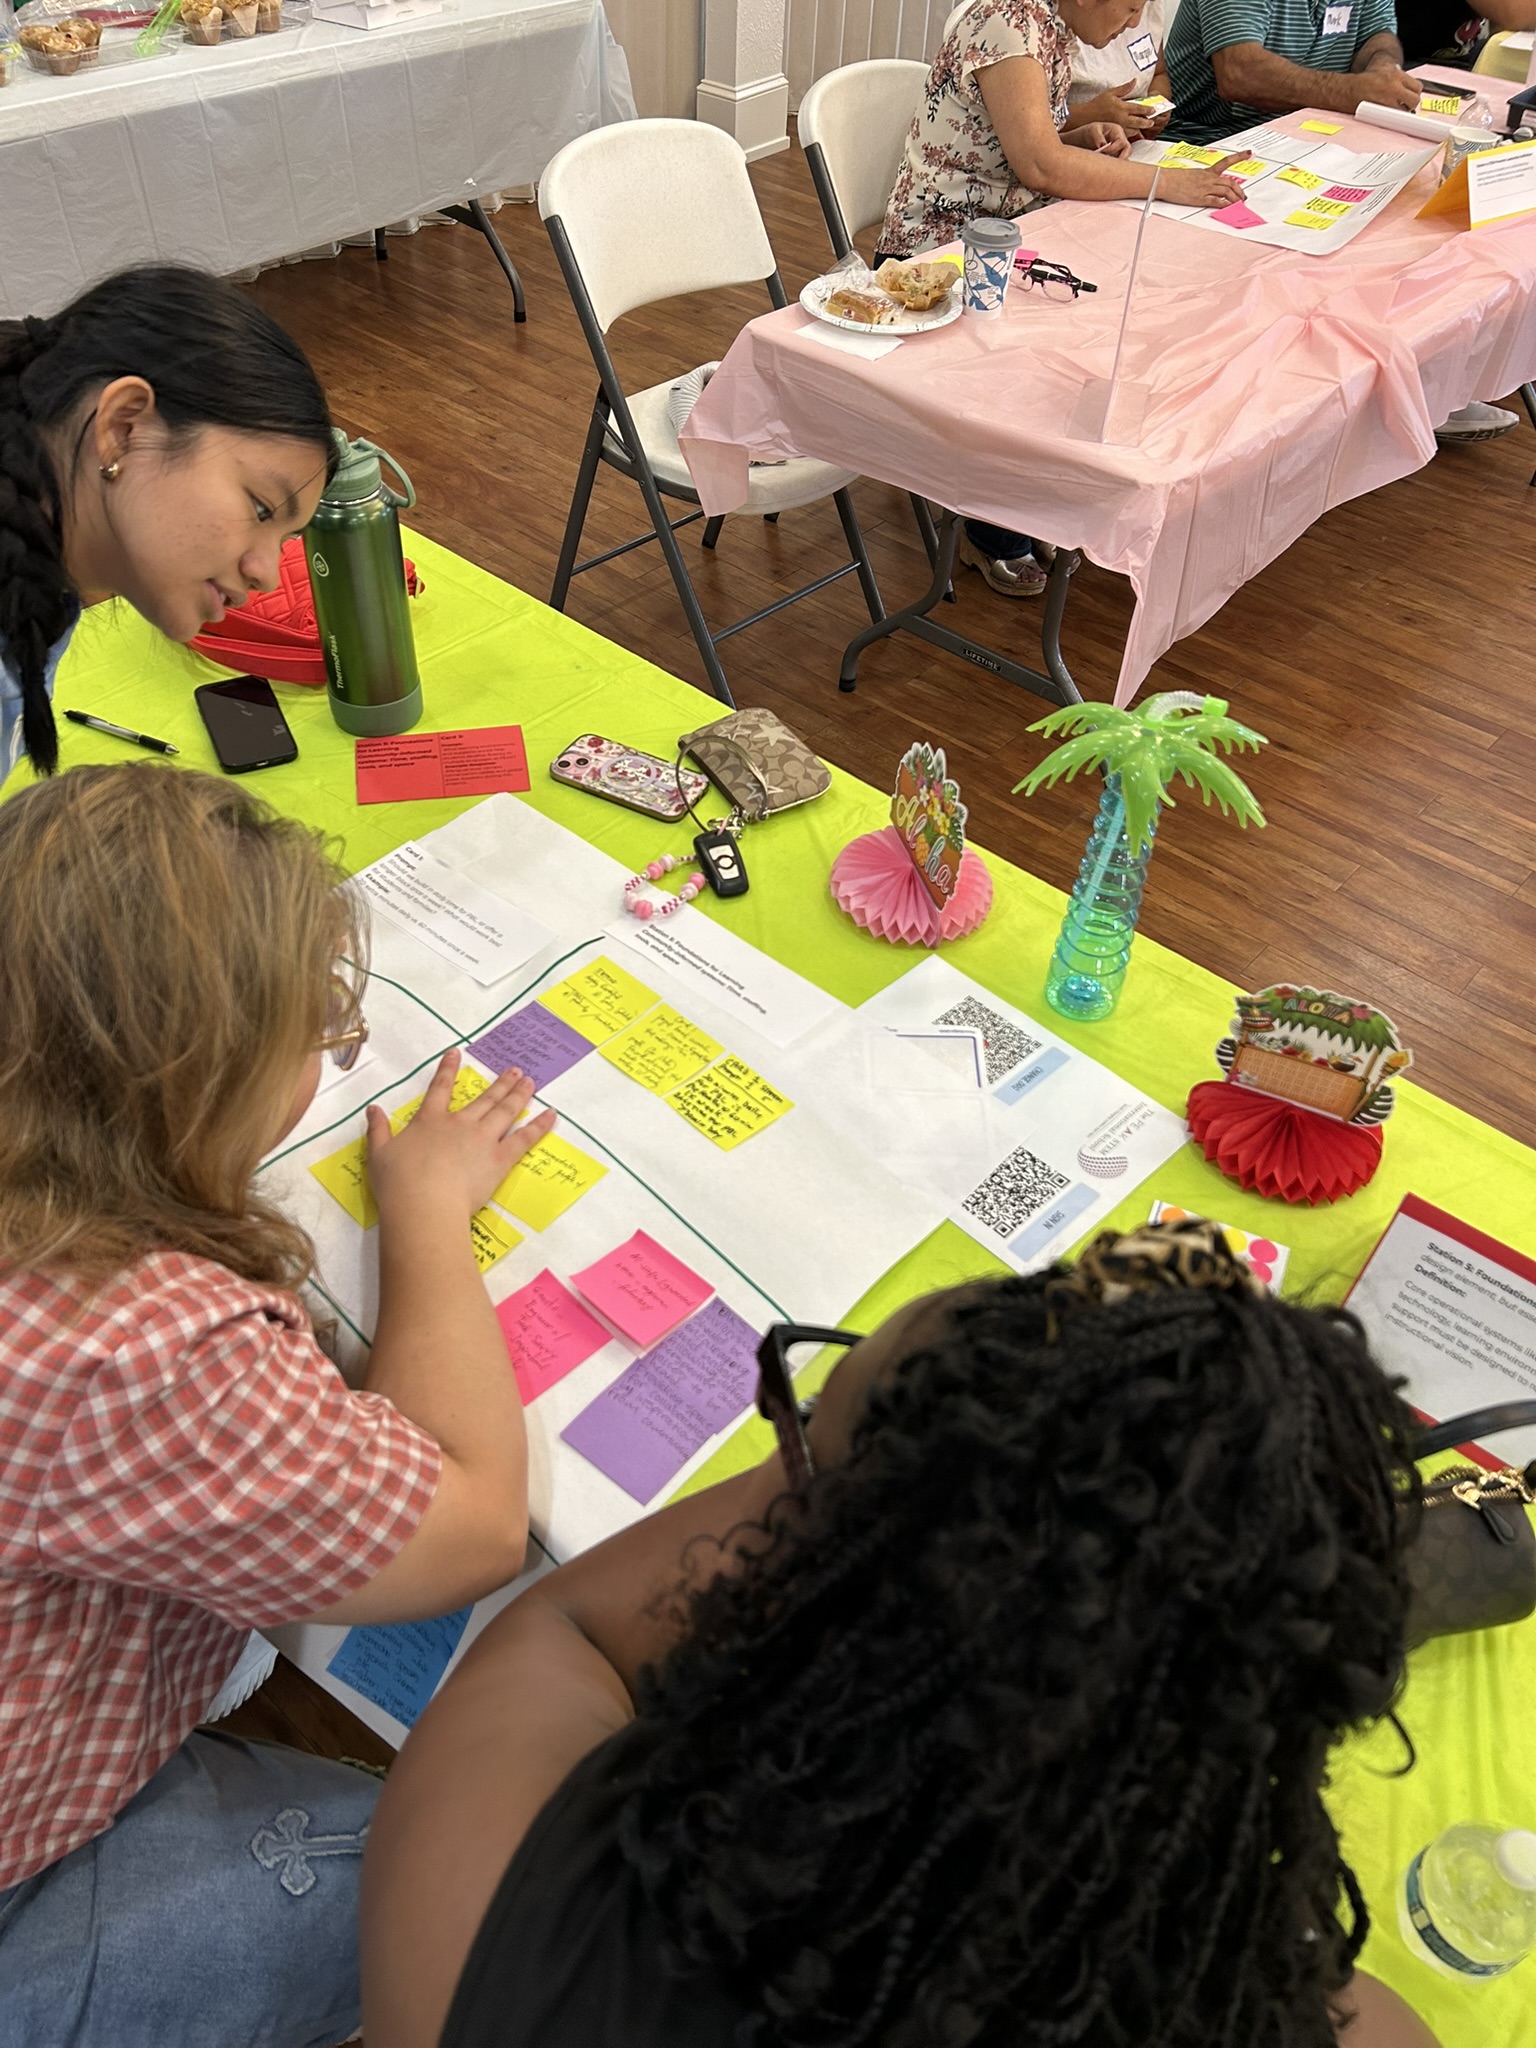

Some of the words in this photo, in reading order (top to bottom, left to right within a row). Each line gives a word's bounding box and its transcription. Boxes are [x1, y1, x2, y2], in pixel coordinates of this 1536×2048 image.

[330, 634, 344, 689] ThermoFlask
[965, 650, 998, 670] LIFETIME
[404, 846, 420, 857] Card
[1283, 998, 1351, 1024] ALOHA
[1111, 1101, 1148, 1135] International
[1141, 1108, 1154, 1120] The
[1089, 1131, 1113, 1152] School
[1099, 1138, 1120, 1156] STEM
[1043, 1221, 1054, 1230] IN
[1050, 1210, 1065, 1225] SIGN
[1414, 1264, 1468, 1298] Definition:
[1420, 1253, 1454, 1275] design
[1454, 1272, 1496, 1302] element,
[1497, 1294, 1517, 1311] but
[1427, 1241, 1464, 1268] Station
[1464, 1262, 1474, 1274] 5:
[1475, 1269, 1536, 1309] Foundations
[1398, 1291, 1451, 1327] technology,
[1453, 1322, 1493, 1351] learning
[1404, 1280, 1427, 1297] Core
[1428, 1293, 1484, 1329] operational
[1384, 1313, 1445, 1352] instructional
[1444, 1347, 1474, 1370] vision.
[1391, 1302, 1429, 1328] support
[1429, 1324, 1456, 1344] must
[1455, 1338, 1470, 1351] be
[1470, 1347, 1516, 1379] designed
[1517, 1374, 1528, 1386] to
